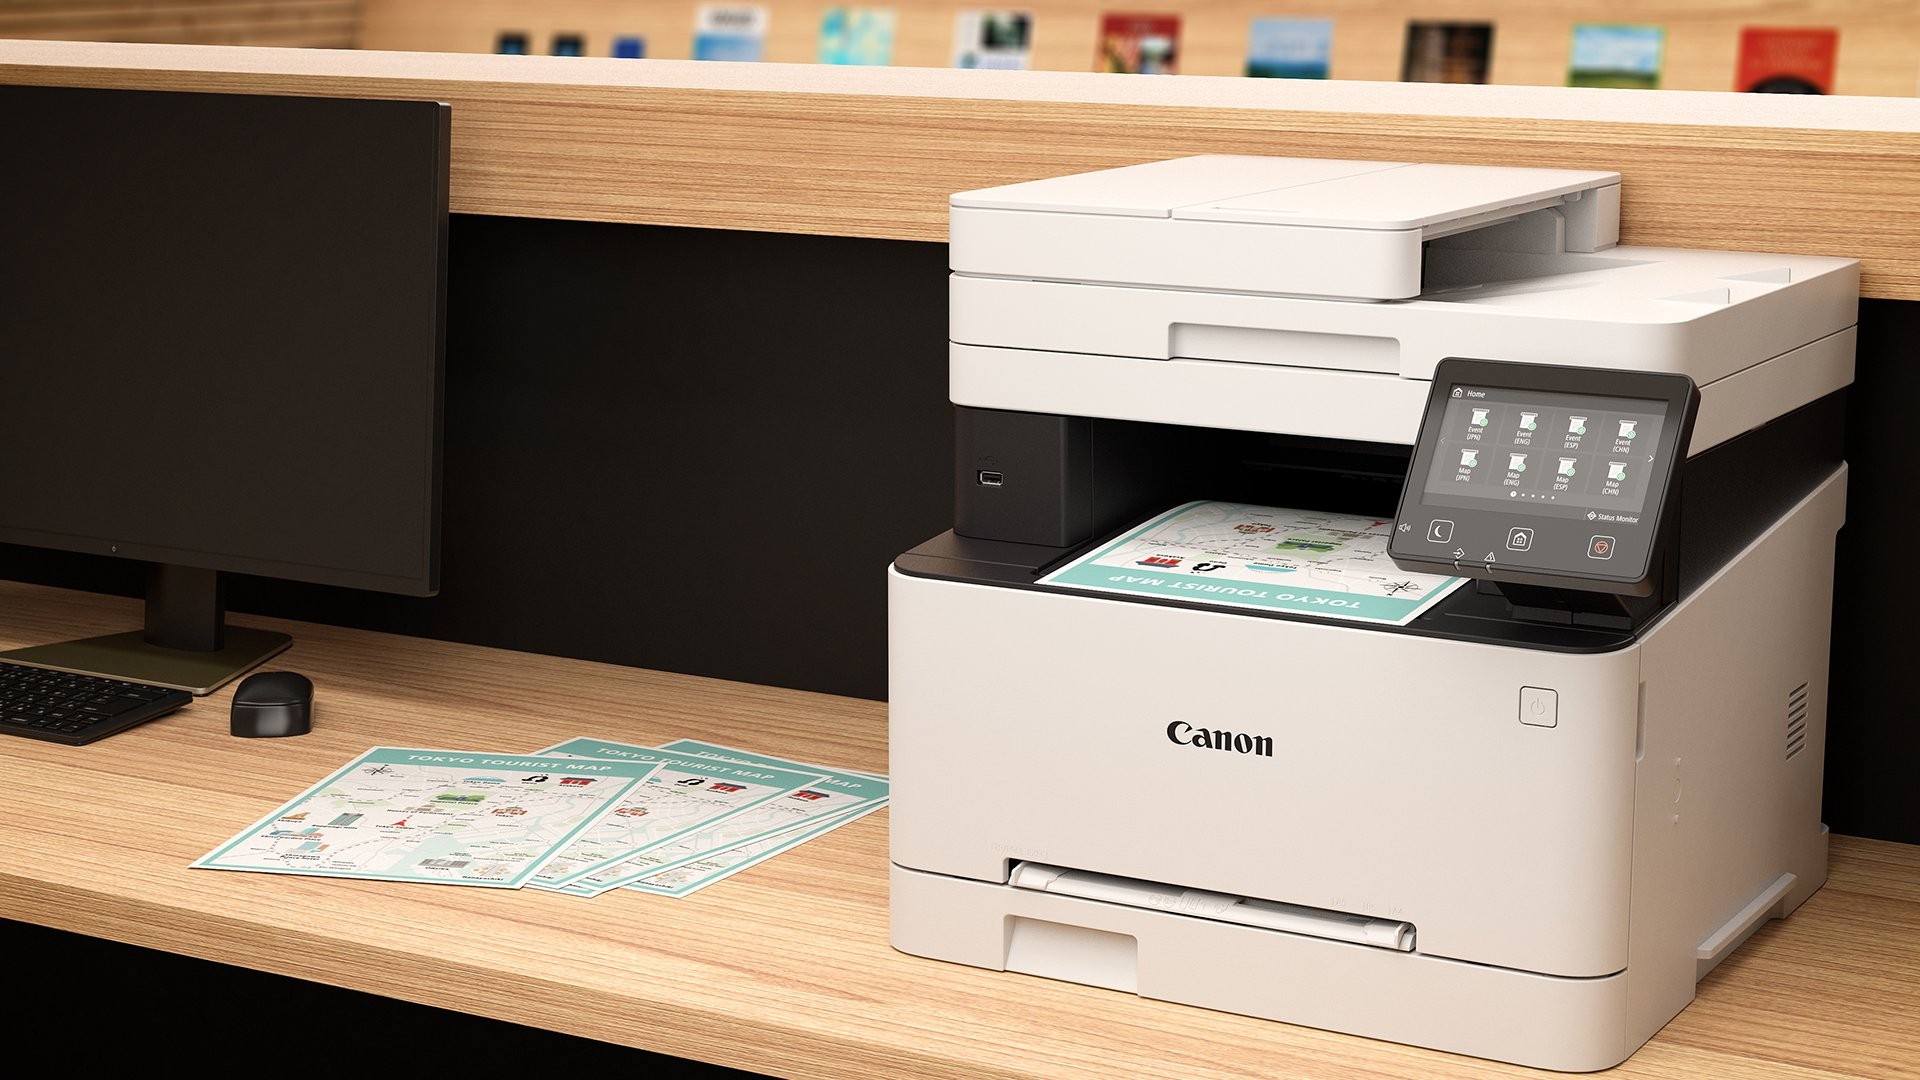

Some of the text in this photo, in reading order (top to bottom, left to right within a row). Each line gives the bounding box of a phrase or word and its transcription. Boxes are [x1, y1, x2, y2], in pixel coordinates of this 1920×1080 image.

[1467, 390, 1486, 398] Home
[1466, 433, 1481, 441] (JPN)
[1516, 430, 1532, 438] Event
[1565, 434, 1581, 442] Event
[1514, 437, 1531, 446] (ENG)
[1563, 441, 1579, 450] (ESP)
[1615, 438, 1631, 446] Event
[1612, 446, 1630, 454] (CHN)
[1458, 467, 1471, 475] Map
[1455, 474, 1471, 482] (JPN)
[1507, 471, 1520, 480] Map
[1503, 479, 1520, 487] (ENG)
[1556, 476, 1569, 484] Map
[1553, 483, 1568, 491] (ESP)
[1605, 480, 1620, 489] Map
[1602, 488, 1620, 496] (CHN)
[1597, 513, 1639, 523] Status Monitor
[1108, 575, 1361, 609] TOKYO TOURIST MAP
[1166, 720, 1273, 757] Canon
[408, 755, 474, 764] TOKYO
[481, 760, 561, 769] TOURIST
[597, 748, 775, 780] TOKYO TOURIST MAP
[825, 778, 862, 789] MAP
